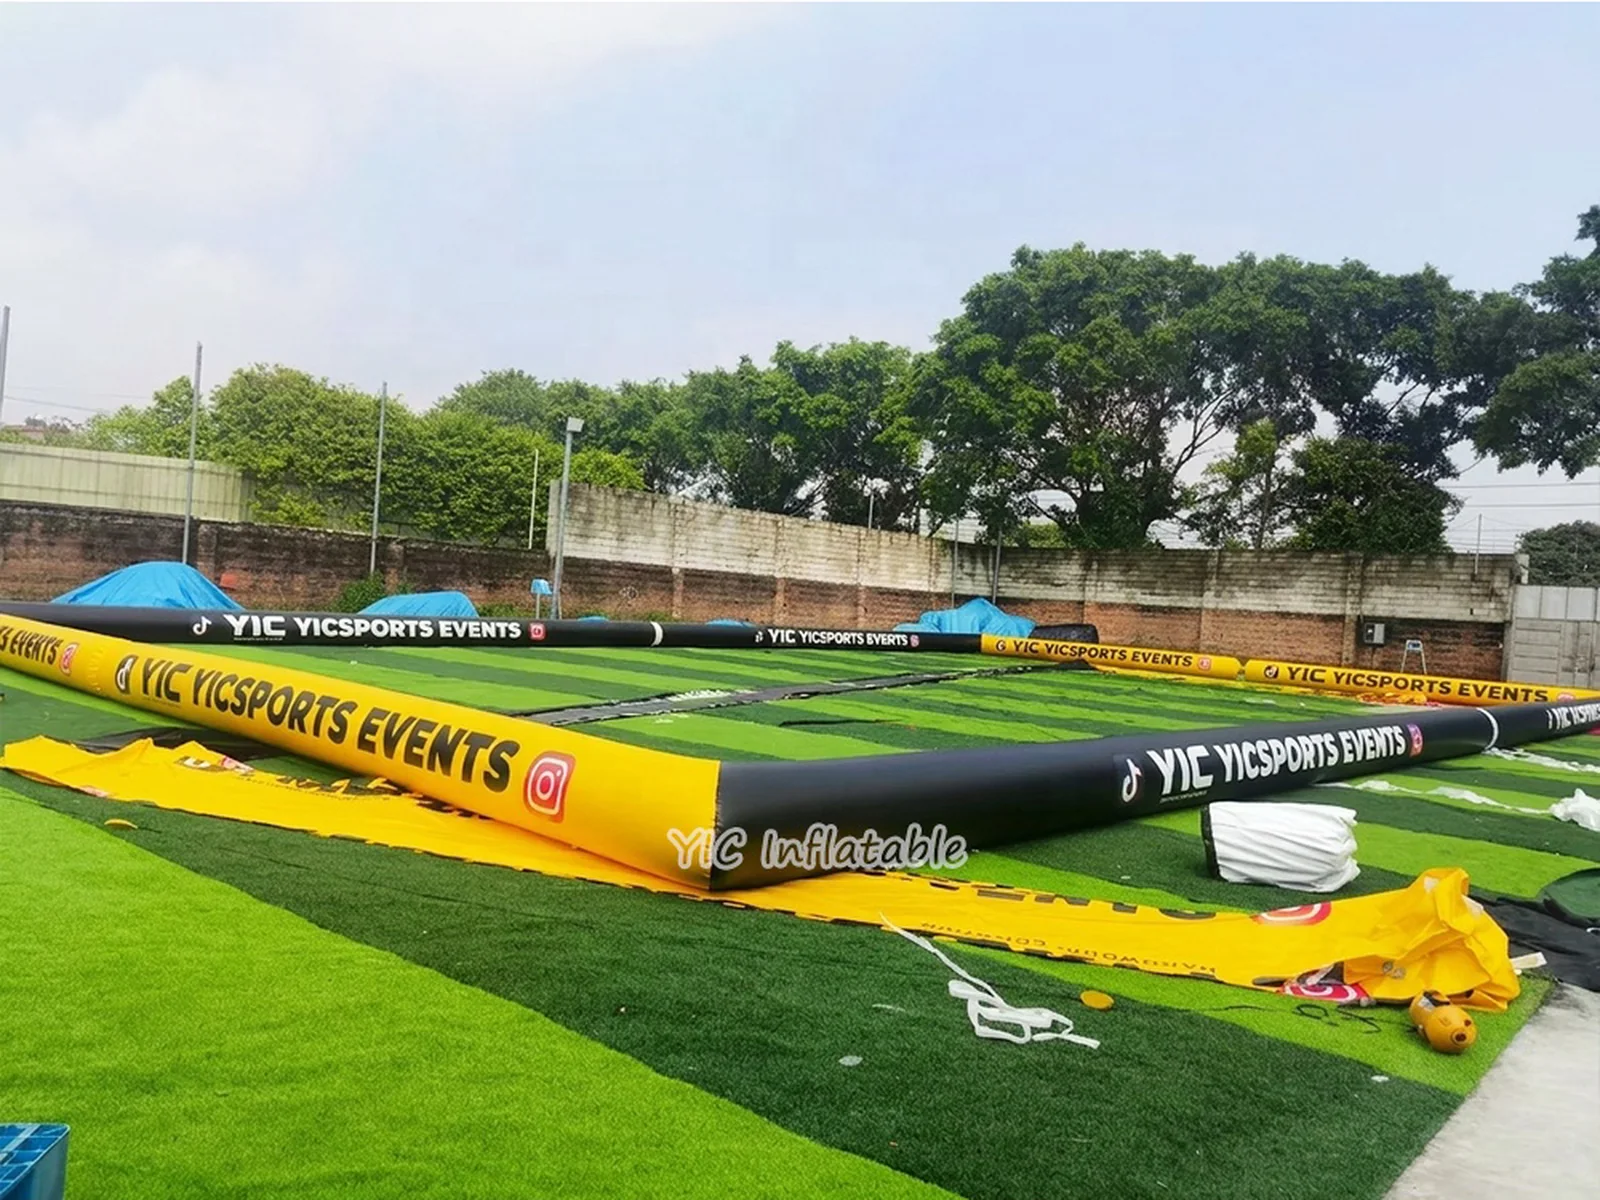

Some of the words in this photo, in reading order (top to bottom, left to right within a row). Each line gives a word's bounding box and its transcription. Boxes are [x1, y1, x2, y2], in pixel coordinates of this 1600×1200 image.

[223, 614, 287, 637] YIC
[293, 616, 434, 639] YICSPORTS
[439, 620, 522, 639] EVENTS
[768, 628, 796, 643] YIC
[799, 630, 865, 645] YICSPORTS
[10, 630, 64, 665] EVENTS
[1013, 640, 1040, 654] YIC
[1044, 642, 1128, 661] YICSPORTS
[1131, 650, 1193, 667] EVENTS
[1287, 666, 1328, 682] YIC
[1333, 671, 1452, 695] YICSPORTS
[1458, 682, 1549, 702] EVENTS
[142, 658, 194, 703] YIC
[192, 668, 359, 745] YICSPORTS
[357, 707, 521, 793] EVENTS
[1146, 745, 1214, 795] YIC
[1213, 732, 1338, 783] YICSPORTS
[1338, 725, 1406, 764] EVENTS
